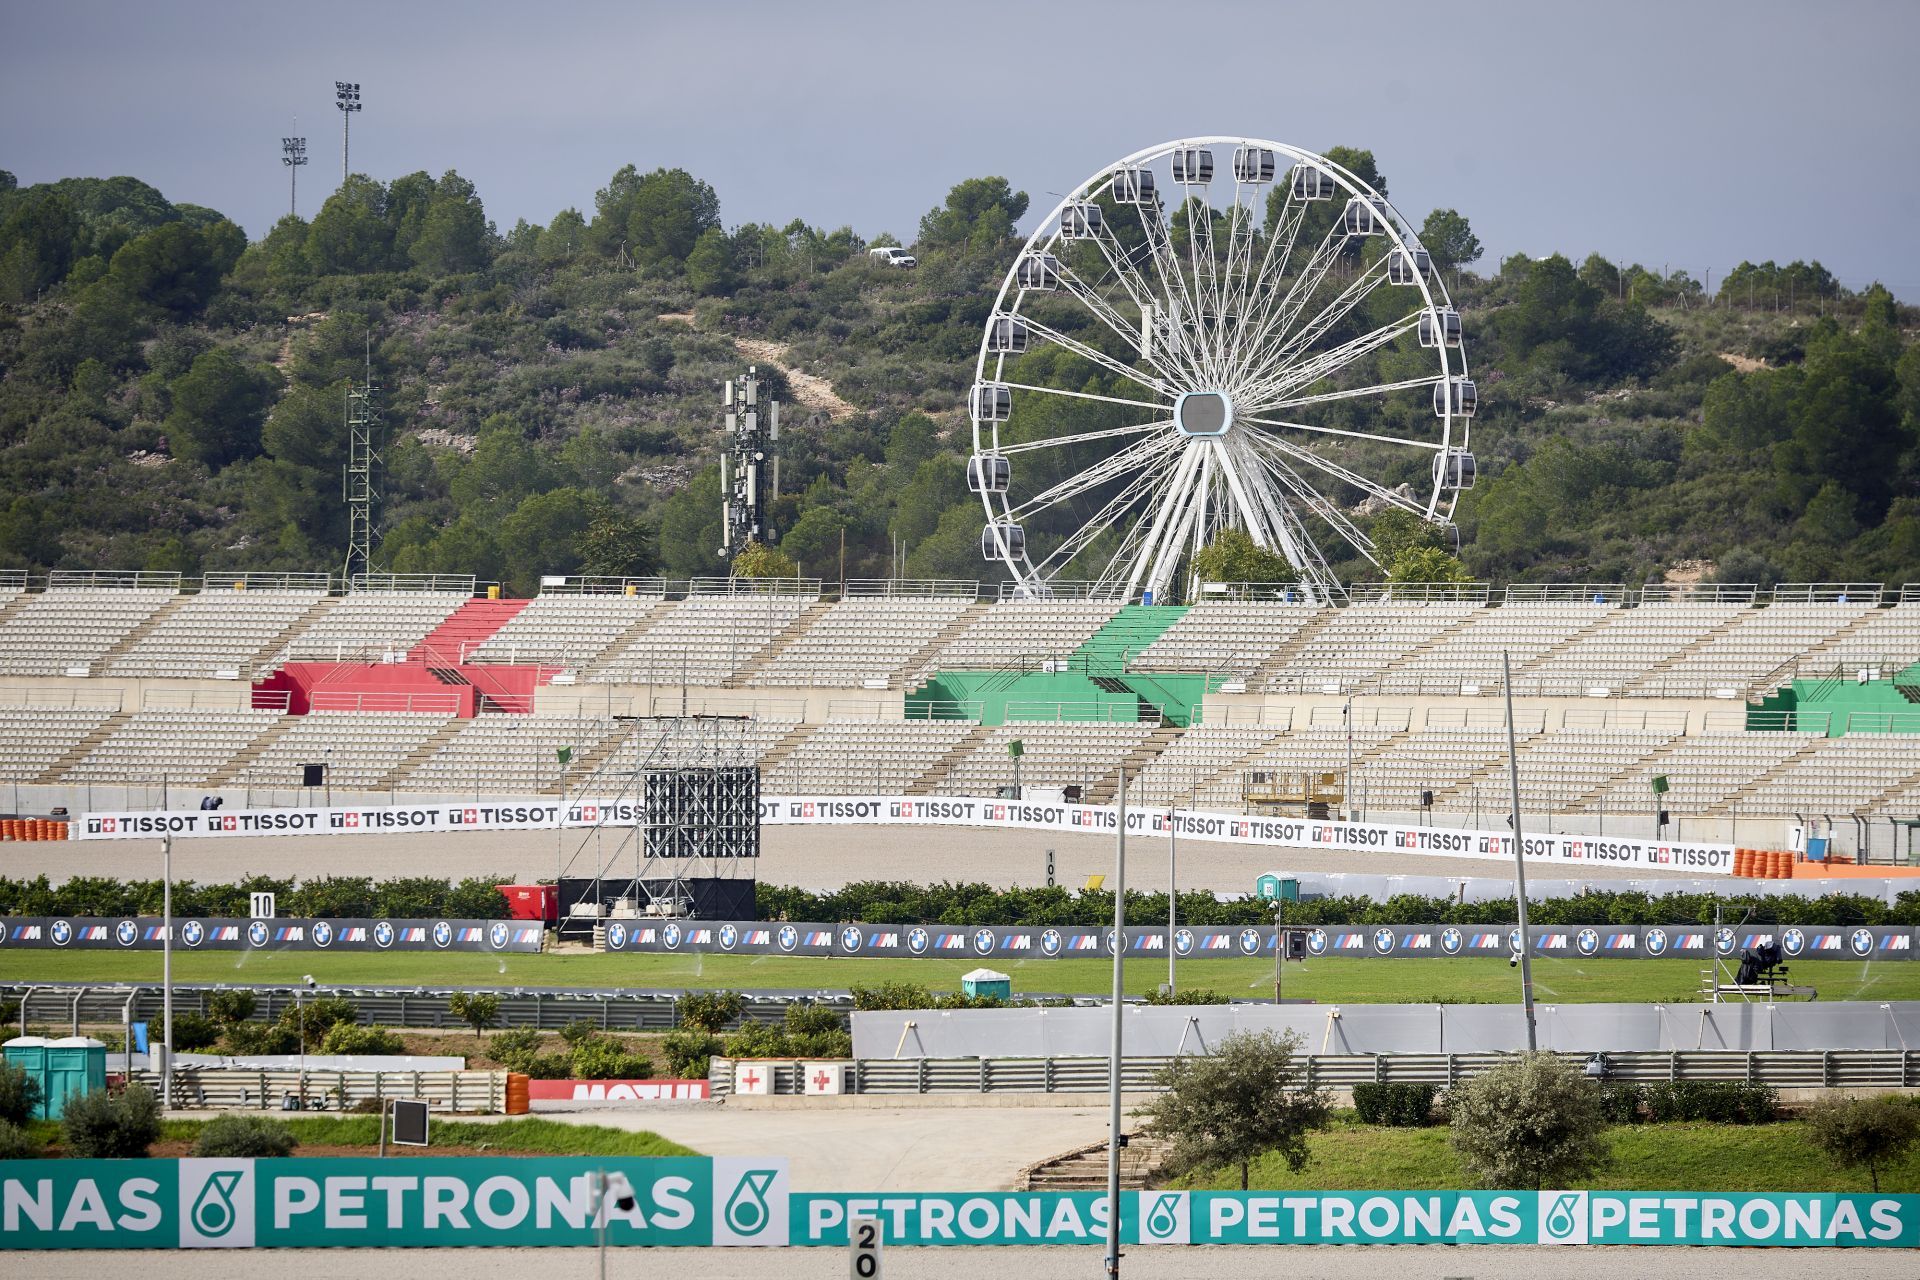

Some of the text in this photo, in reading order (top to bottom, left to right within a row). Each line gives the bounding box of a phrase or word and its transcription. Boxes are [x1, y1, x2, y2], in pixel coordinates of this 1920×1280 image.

[362, 811, 439, 827] TISSOT
[481, 808, 557, 823] TISSOT
[600, 805, 645, 820] TISS
[817, 802, 881, 818] TISSOT
[915, 802, 974, 818] TISSOT
[1008, 805, 1064, 823] TISSOT
[119, 816, 198, 832] TISSOT
[240, 814, 318, 830] TISSOT
[1094, 812, 1145, 829] TISOT
[1173, 816, 1225, 835] TISSOT
[1251, 823, 1304, 840] TISSOT
[1334, 828, 1387, 845] TISSOT
[1795, 828, 1801, 848] 7
[1419, 833, 1471, 851] TISSOT
[1501, 838, 1555, 856] TISOT
[1584, 843, 1641, 861] TISSOT
[1672, 848, 1730, 866] TISSOT
[254, 895, 272, 917] 10
[4, 1177, 162, 1232] NAS
[274, 1175, 695, 1230] PETRONAS
[809, 1197, 1122, 1239] PETRONAS
[1210, 1196, 1521, 1238] PETRONAS
[1593, 1197, 1903, 1240] PETRONAS
[856, 1224, 876, 1278] 20
